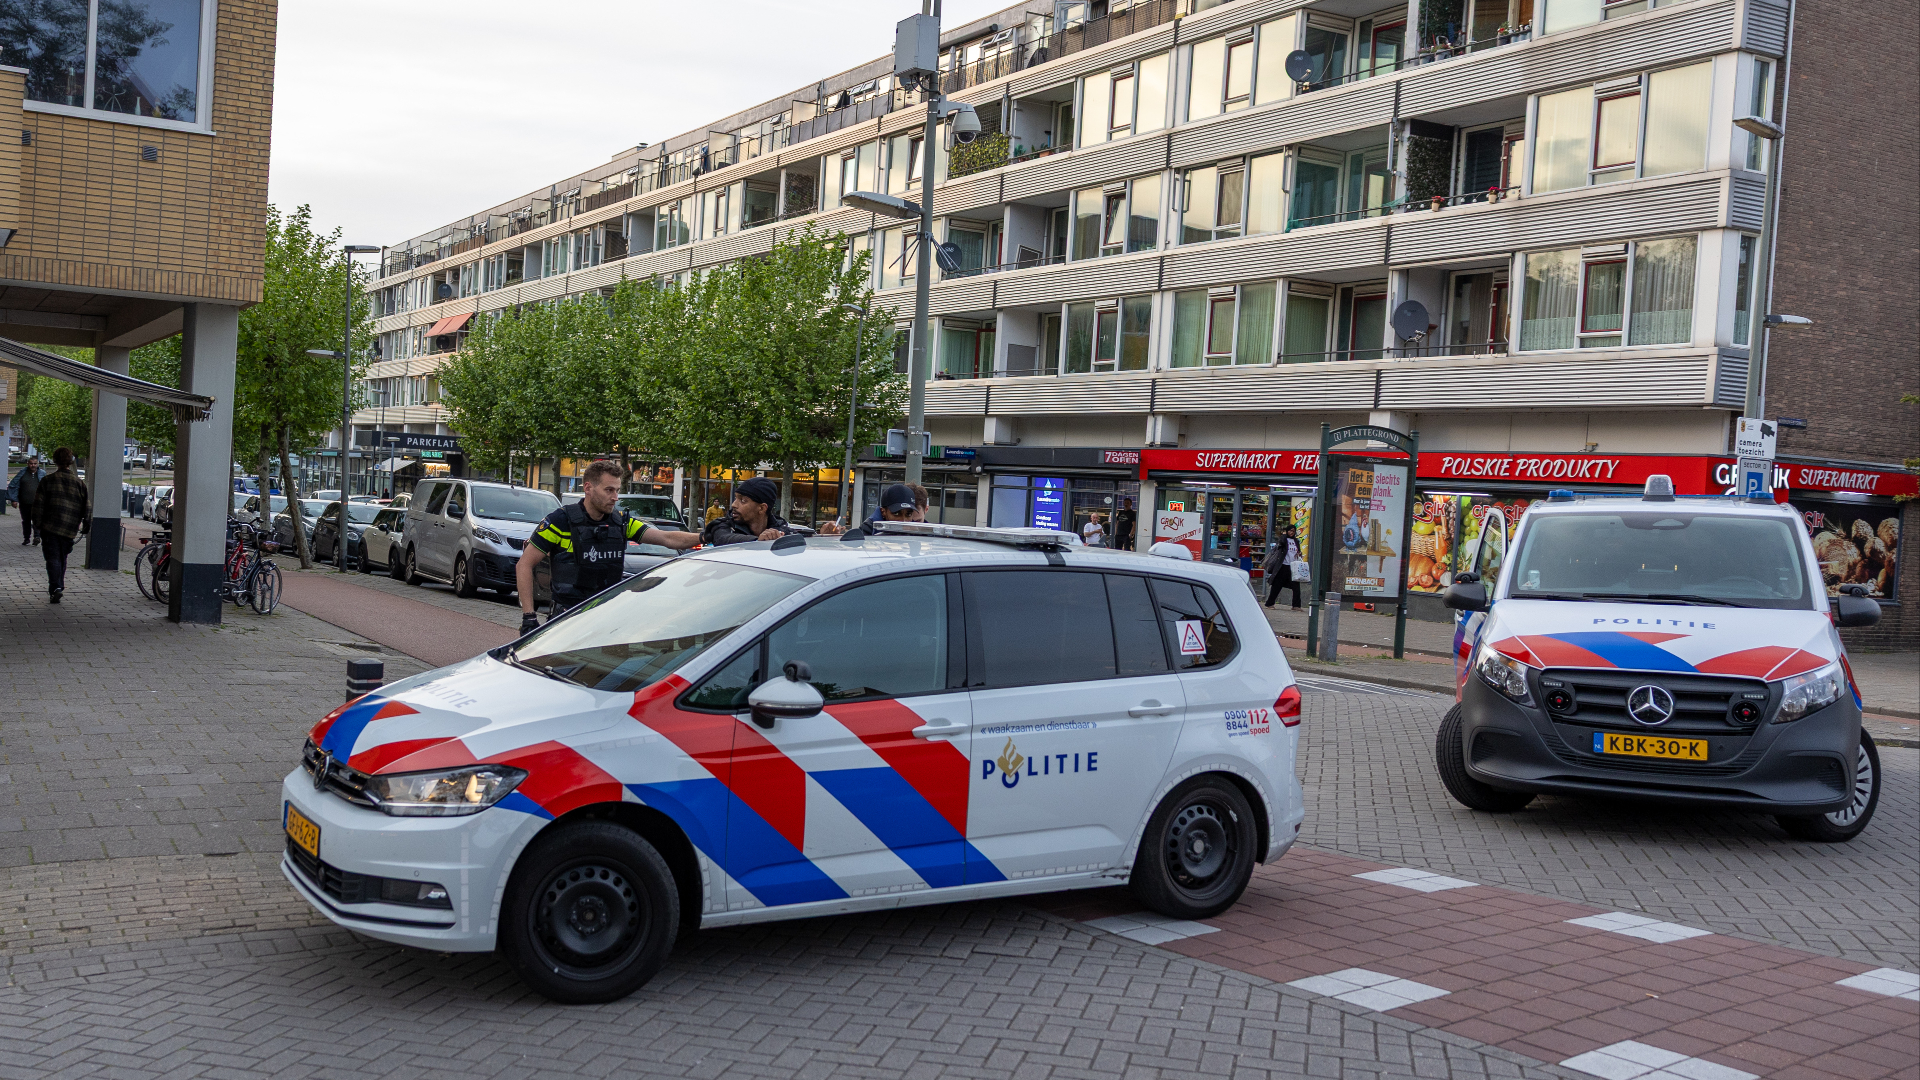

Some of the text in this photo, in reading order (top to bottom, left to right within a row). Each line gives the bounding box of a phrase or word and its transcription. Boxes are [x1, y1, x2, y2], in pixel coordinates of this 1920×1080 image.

[1343, 428, 1399, 442] PLATTEGROND
[407, 437, 454, 448] PARKFLAT
[1739, 440, 1762, 448] camera
[1106, 451, 1112, 463] 7
[1738, 447, 1764, 456] toezicht
[1195, 452, 1282, 470] SUPERMARKT
[1441, 456, 1513, 476] POLSKIE
[1515, 459, 1620, 479] PRODUKTY
[1351, 471, 1400, 485] Het is slechts
[1799, 468, 1880, 490] SUPERMARKT
[1749, 479, 1758, 492] P
[1358, 486, 1394, 498] een plank.
[583, 551, 622, 562] POLITIE
[1593, 618, 1716, 629] POLITIE
[1225, 708, 1269, 724] 0900 112
[1226, 720, 1248, 730] 8844
[1250, 725, 1270, 736] spoed
[1610, 736, 1700, 757] KBK-30-K
[982, 752, 1098, 788] POLITIE
